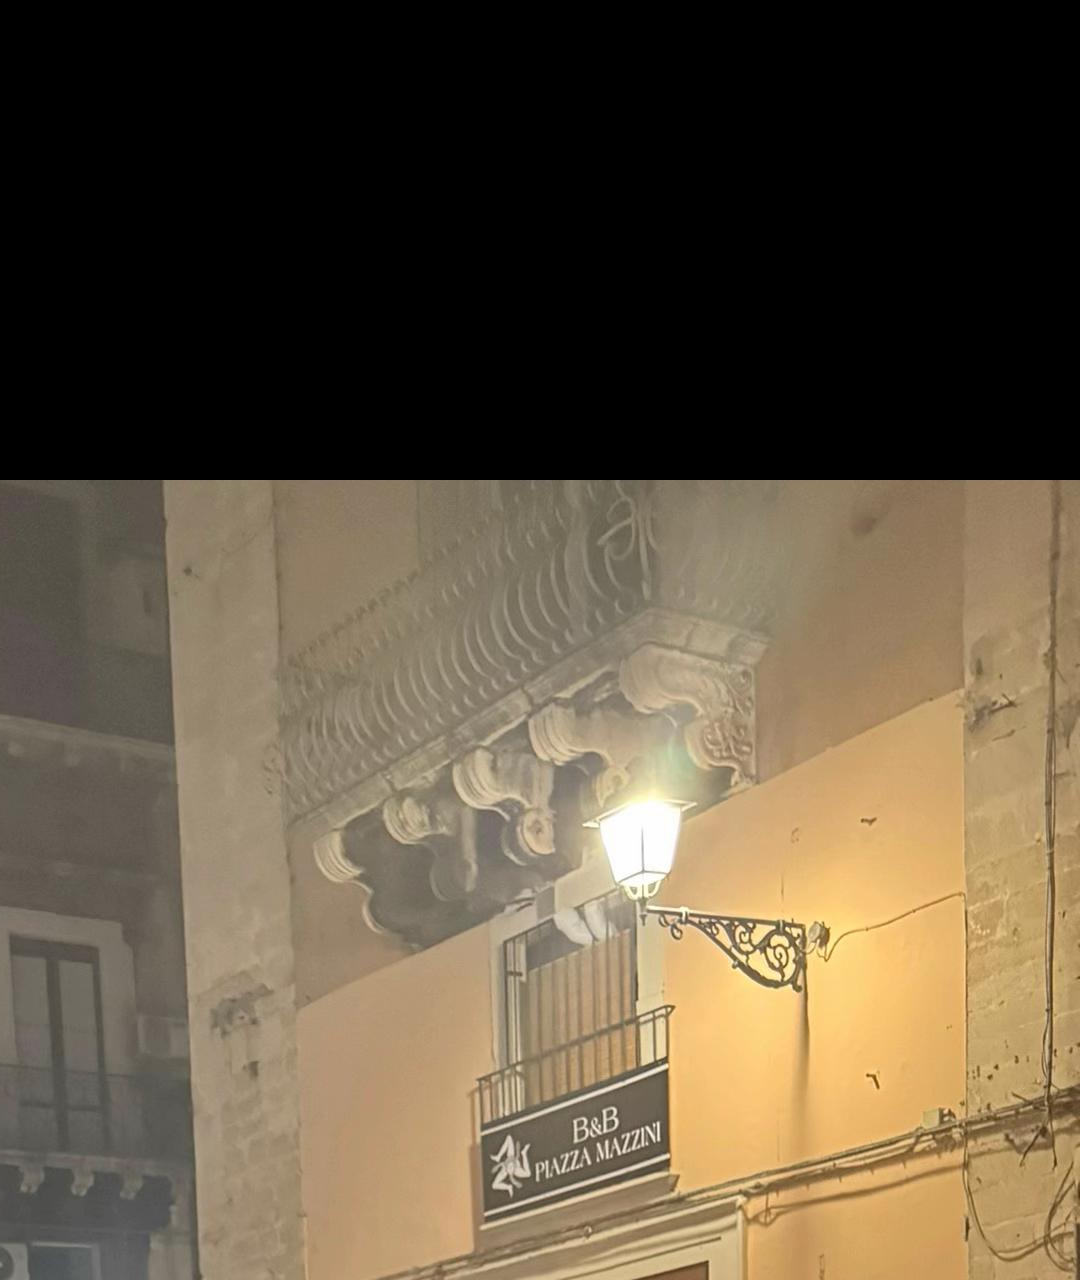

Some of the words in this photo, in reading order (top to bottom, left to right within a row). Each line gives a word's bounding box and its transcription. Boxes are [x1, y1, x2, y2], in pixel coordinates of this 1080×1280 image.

[572, 1105, 619, 1144] B&B
[535, 1148, 592, 1183] PIAZZA
[596, 1120, 661, 1163] MAZZINI
